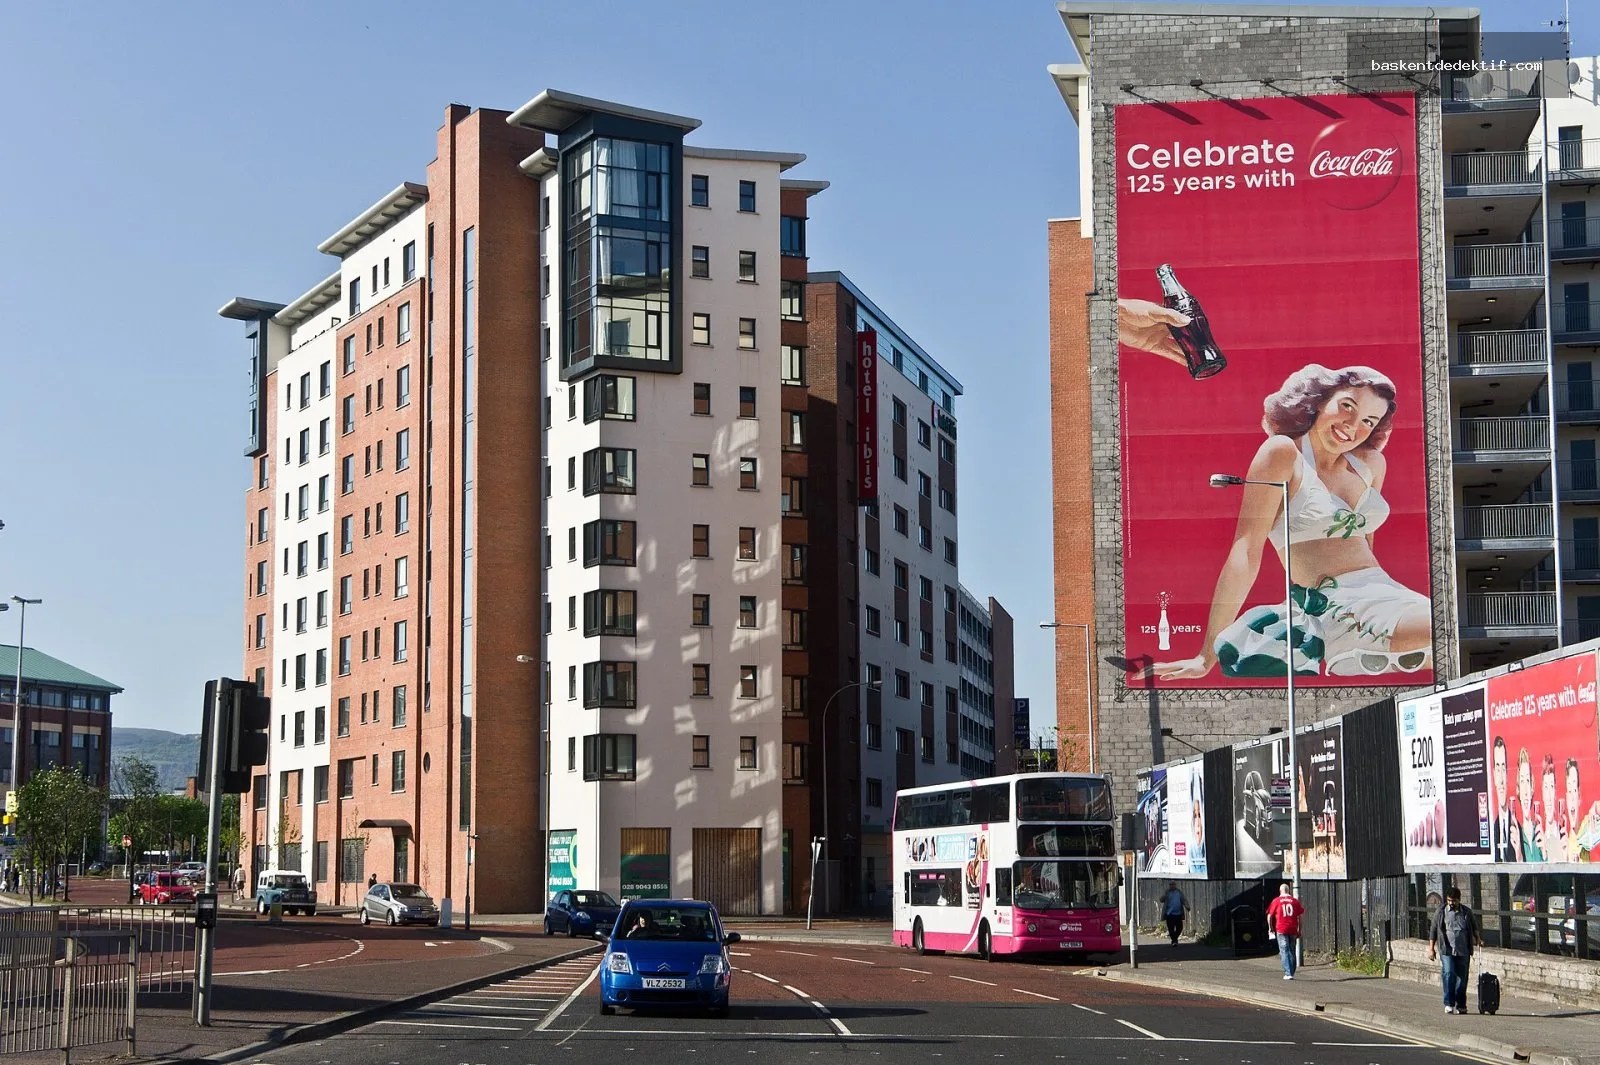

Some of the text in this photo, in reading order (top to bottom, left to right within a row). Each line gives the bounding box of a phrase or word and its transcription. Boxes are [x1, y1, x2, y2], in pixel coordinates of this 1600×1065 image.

[1127, 139, 1295, 169] Celebrate
[1309, 147, 1398, 178] Coca-Cola
[1127, 168, 1295, 195] 125 years with
[862, 341, 872, 413] hotel
[864, 427, 872, 488] ibis
[1140, 625, 1156, 634] 125
[1172, 624, 1202, 634] years
[1490, 699, 1522, 721] Celebrate
[1523, 693, 1536, 715] 125
[1536, 692, 1557, 717] years
[1558, 684, 1577, 707] with
[1411, 736, 1434, 769] £200
[1281, 903, 1294, 918] 10
[645, 979, 683, 988] VLZ 2532
